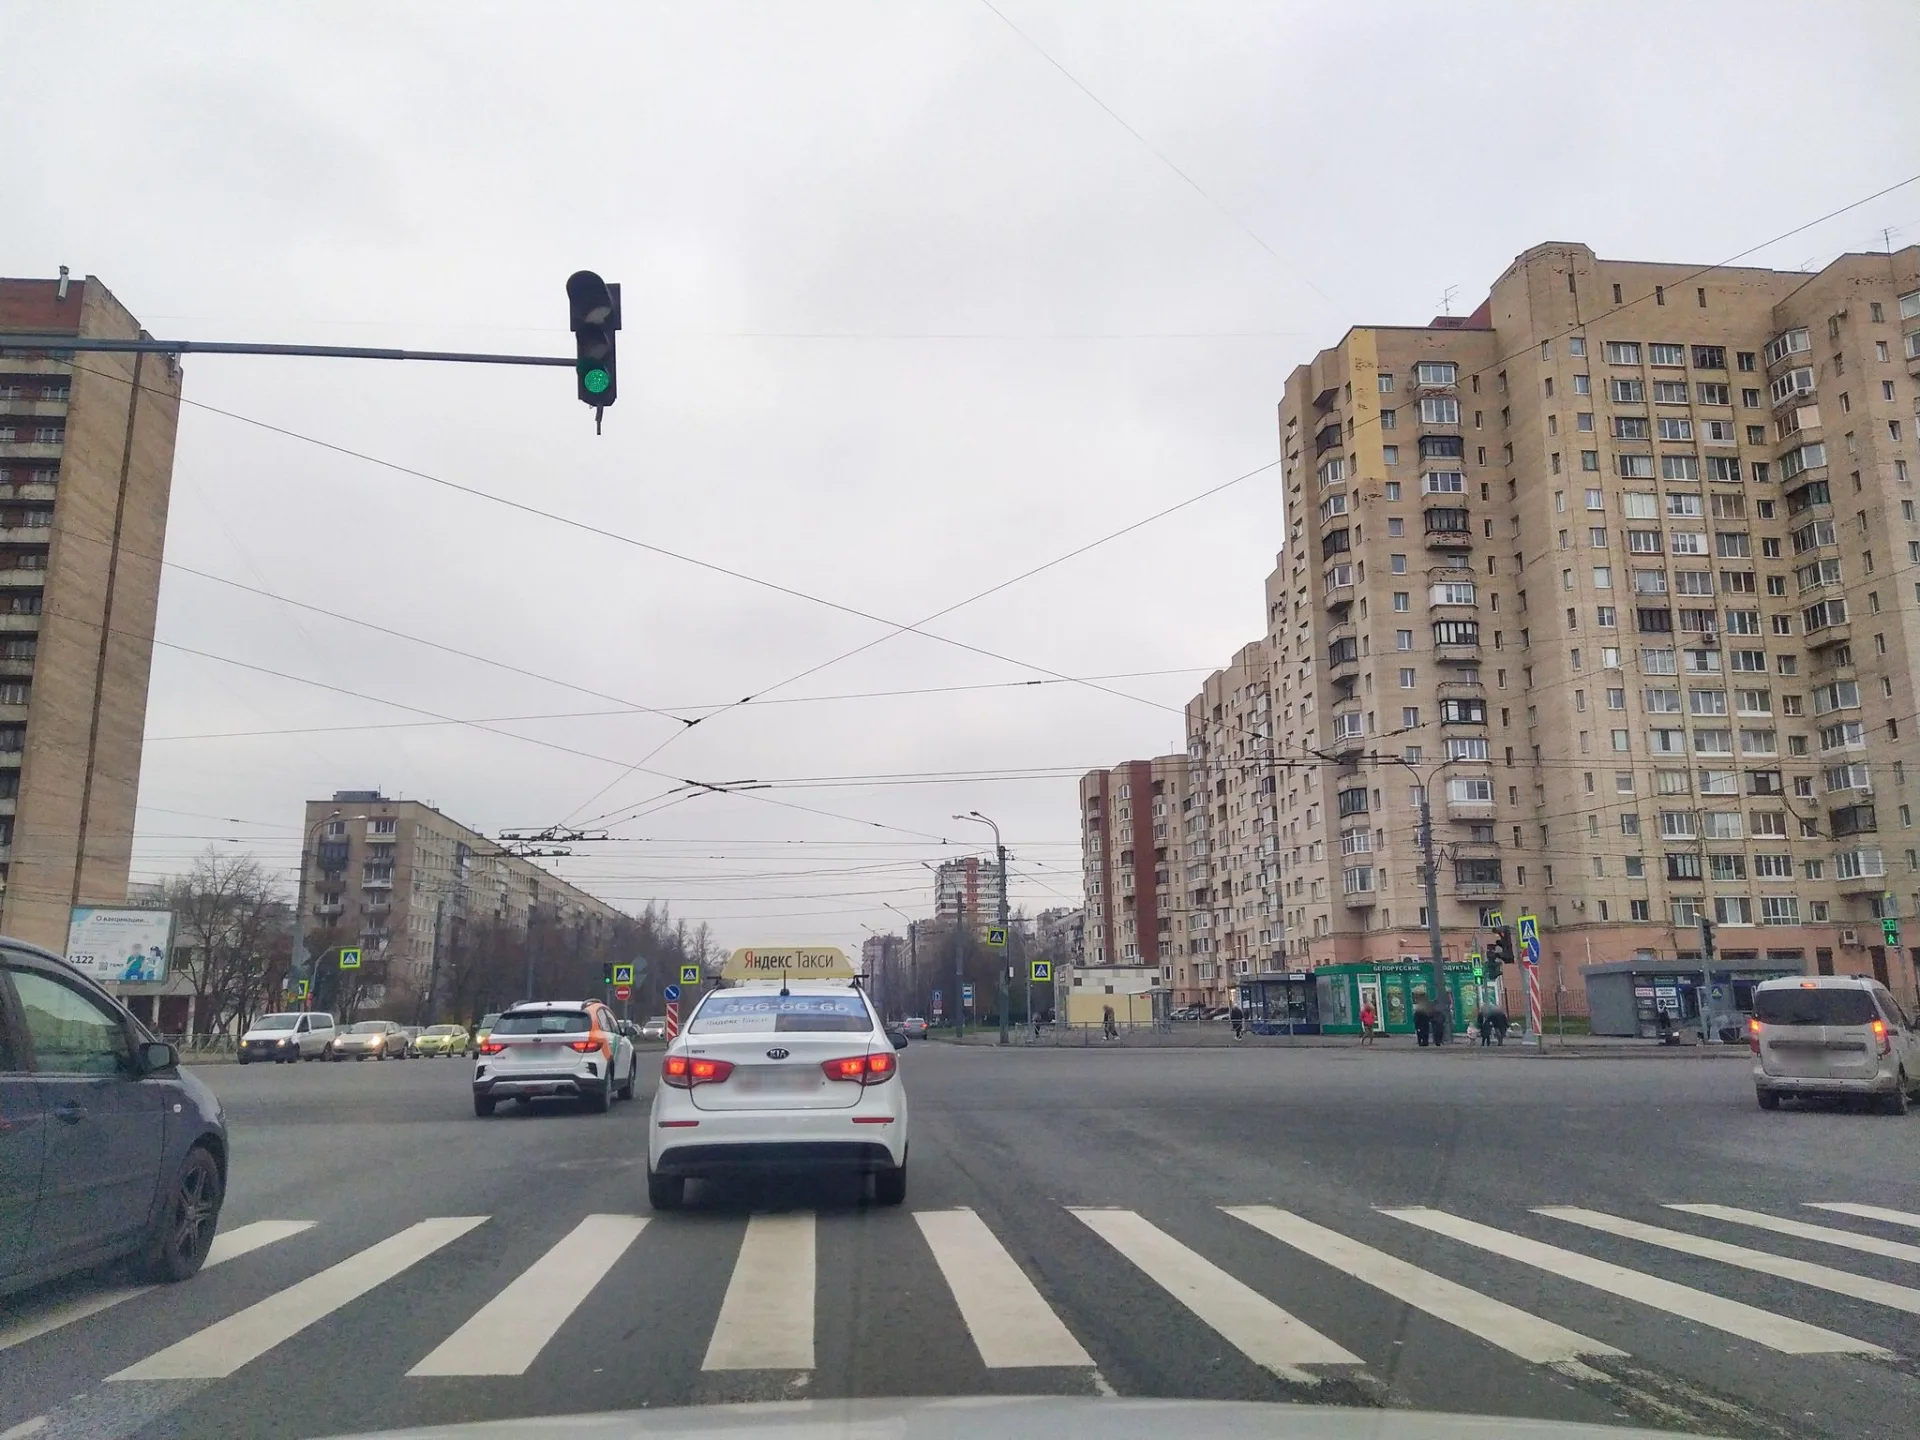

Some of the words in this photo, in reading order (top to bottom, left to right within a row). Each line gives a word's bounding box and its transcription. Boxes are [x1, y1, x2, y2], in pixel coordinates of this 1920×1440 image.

[75, 955, 94, 964] 122
[744, 951, 792, 970] Яндекс
[795, 951, 834, 968] Такси
[769, 1050, 787, 1058] KIA
